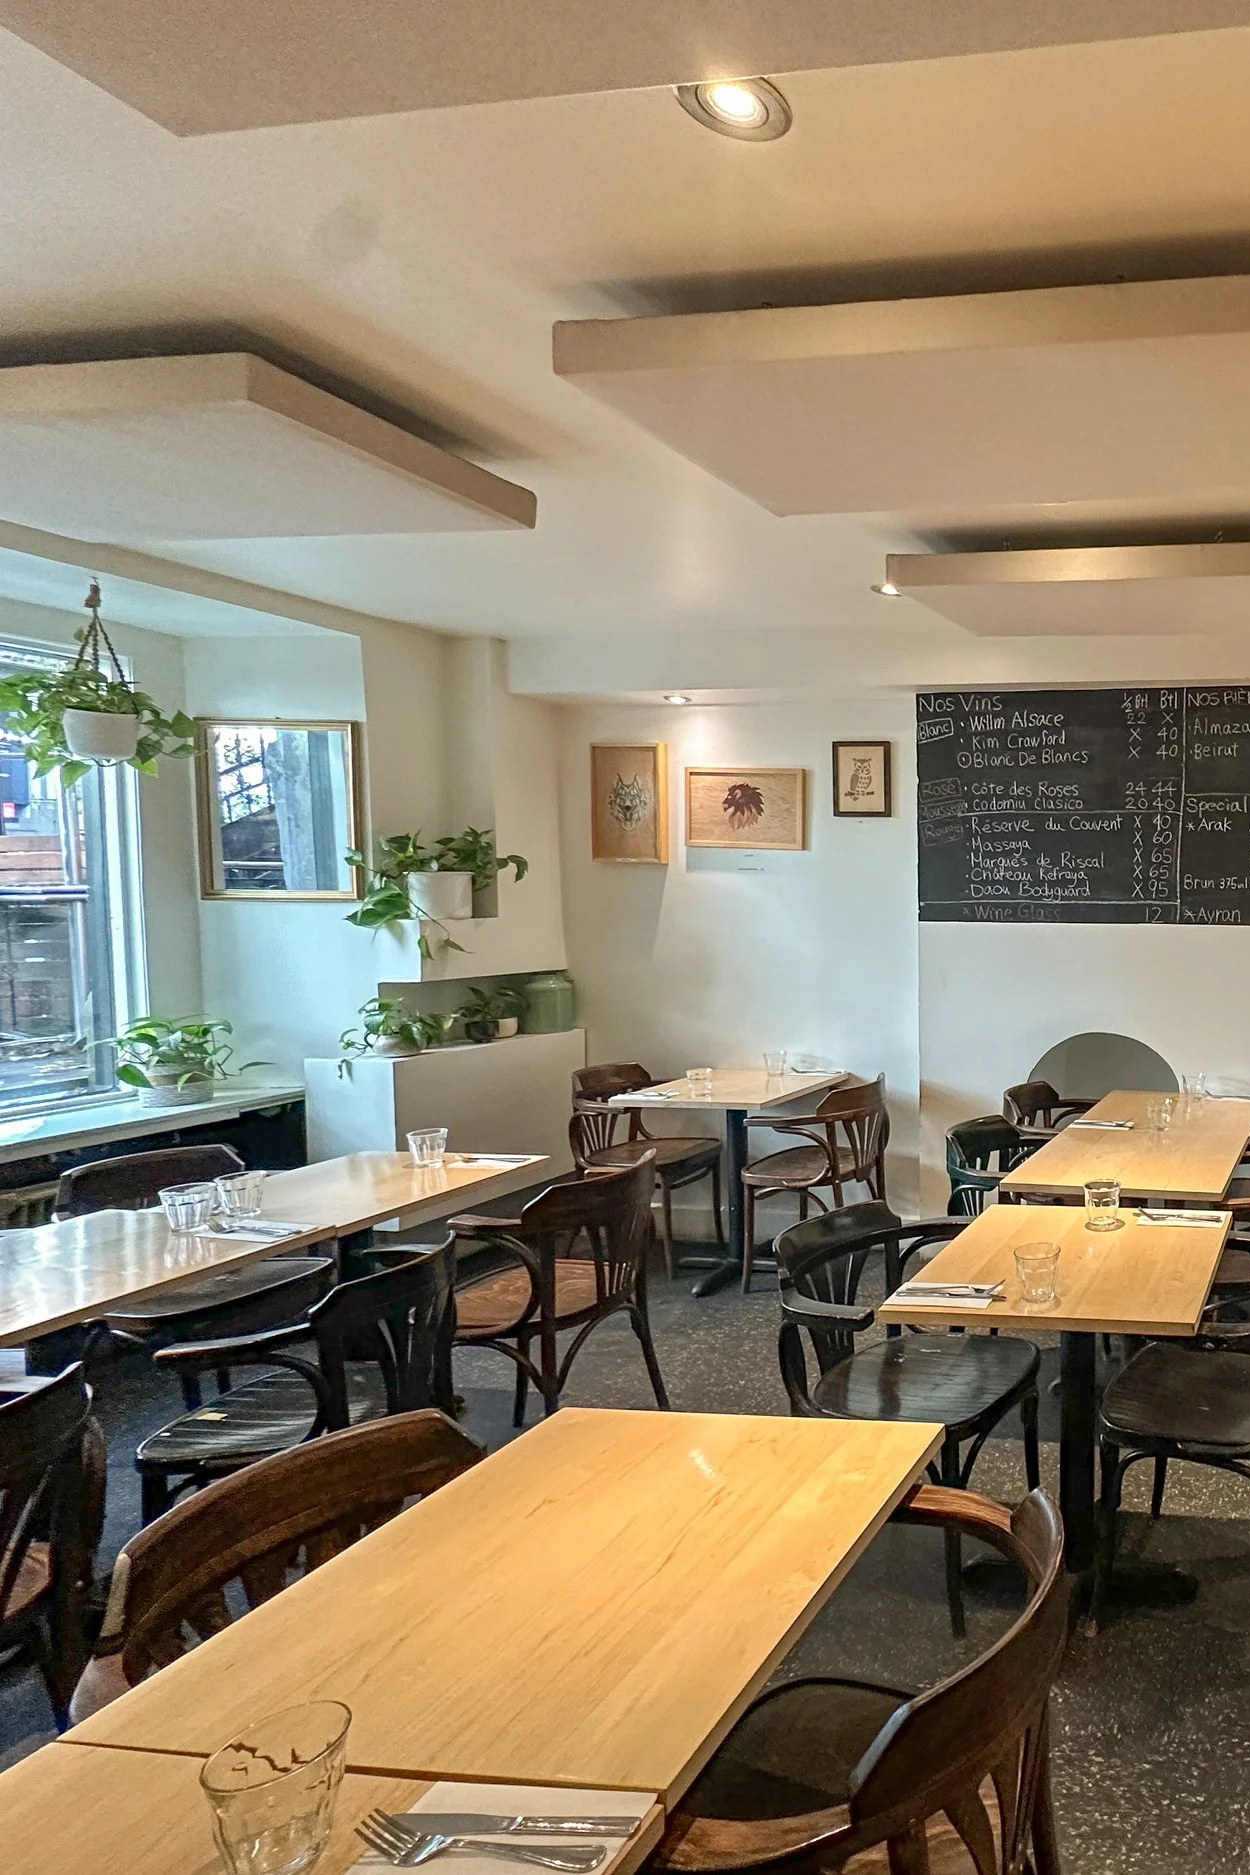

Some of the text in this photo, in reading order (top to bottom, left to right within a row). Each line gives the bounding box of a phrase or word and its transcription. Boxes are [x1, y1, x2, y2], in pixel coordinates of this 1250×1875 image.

[920, 694, 955, 712] Nos
[958, 694, 1003, 711] Vins
[1160, 690, 1178, 709] Btl
[1188, 692, 1219, 707] NOS
[1011, 711, 1064, 728] Alsace
[1126, 712, 1146, 725] 22
[919, 723, 949, 740] Blanc
[972, 736, 1000, 750] Kim
[1007, 730, 1065, 749] Crawford
[1157, 727, 1178, 742] 40
[974, 752, 1014, 768] Blanc
[1018, 752, 1037, 766] De
[1042, 748, 1089, 764] Blancs
[1156, 744, 1178, 760] 40
[1194, 742, 1239, 760] Beirut
[1009, 781, 1032, 796] des
[1038, 781, 1079, 797] Roses
[1125, 782, 1146, 796] 24
[1151, 781, 1177, 796] 44
[1125, 797, 1148, 810] 20
[1152, 797, 1176, 811] 40
[1186, 796, 1248, 818] Special
[971, 817, 1035, 835] Réserve
[1045, 817, 1066, 832] du
[1069, 814, 1123, 832] Couvent
[1153, 814, 1172, 831] 40
[1198, 817, 1232, 832] Arak
[971, 836, 1032, 856] Massaya
[1152, 831, 1173, 845] 60
[1036, 852, 1052, 868] de
[1061, 851, 1104, 868] Riscal
[1151, 848, 1173, 864] 65
[971, 866, 1033, 881] Château
[1150, 864, 1169, 880] 65
[1183, 873, 1215, 890] Brun
[971, 883, 1011, 898] Daou
[1018, 880, 1091, 902] Bodyguard
[1148, 879, 1169, 899] 95
[974, 904, 1012, 920] Wine
[1145, 906, 1164, 923] 12
[1197, 906, 1241, 924] Ayran
